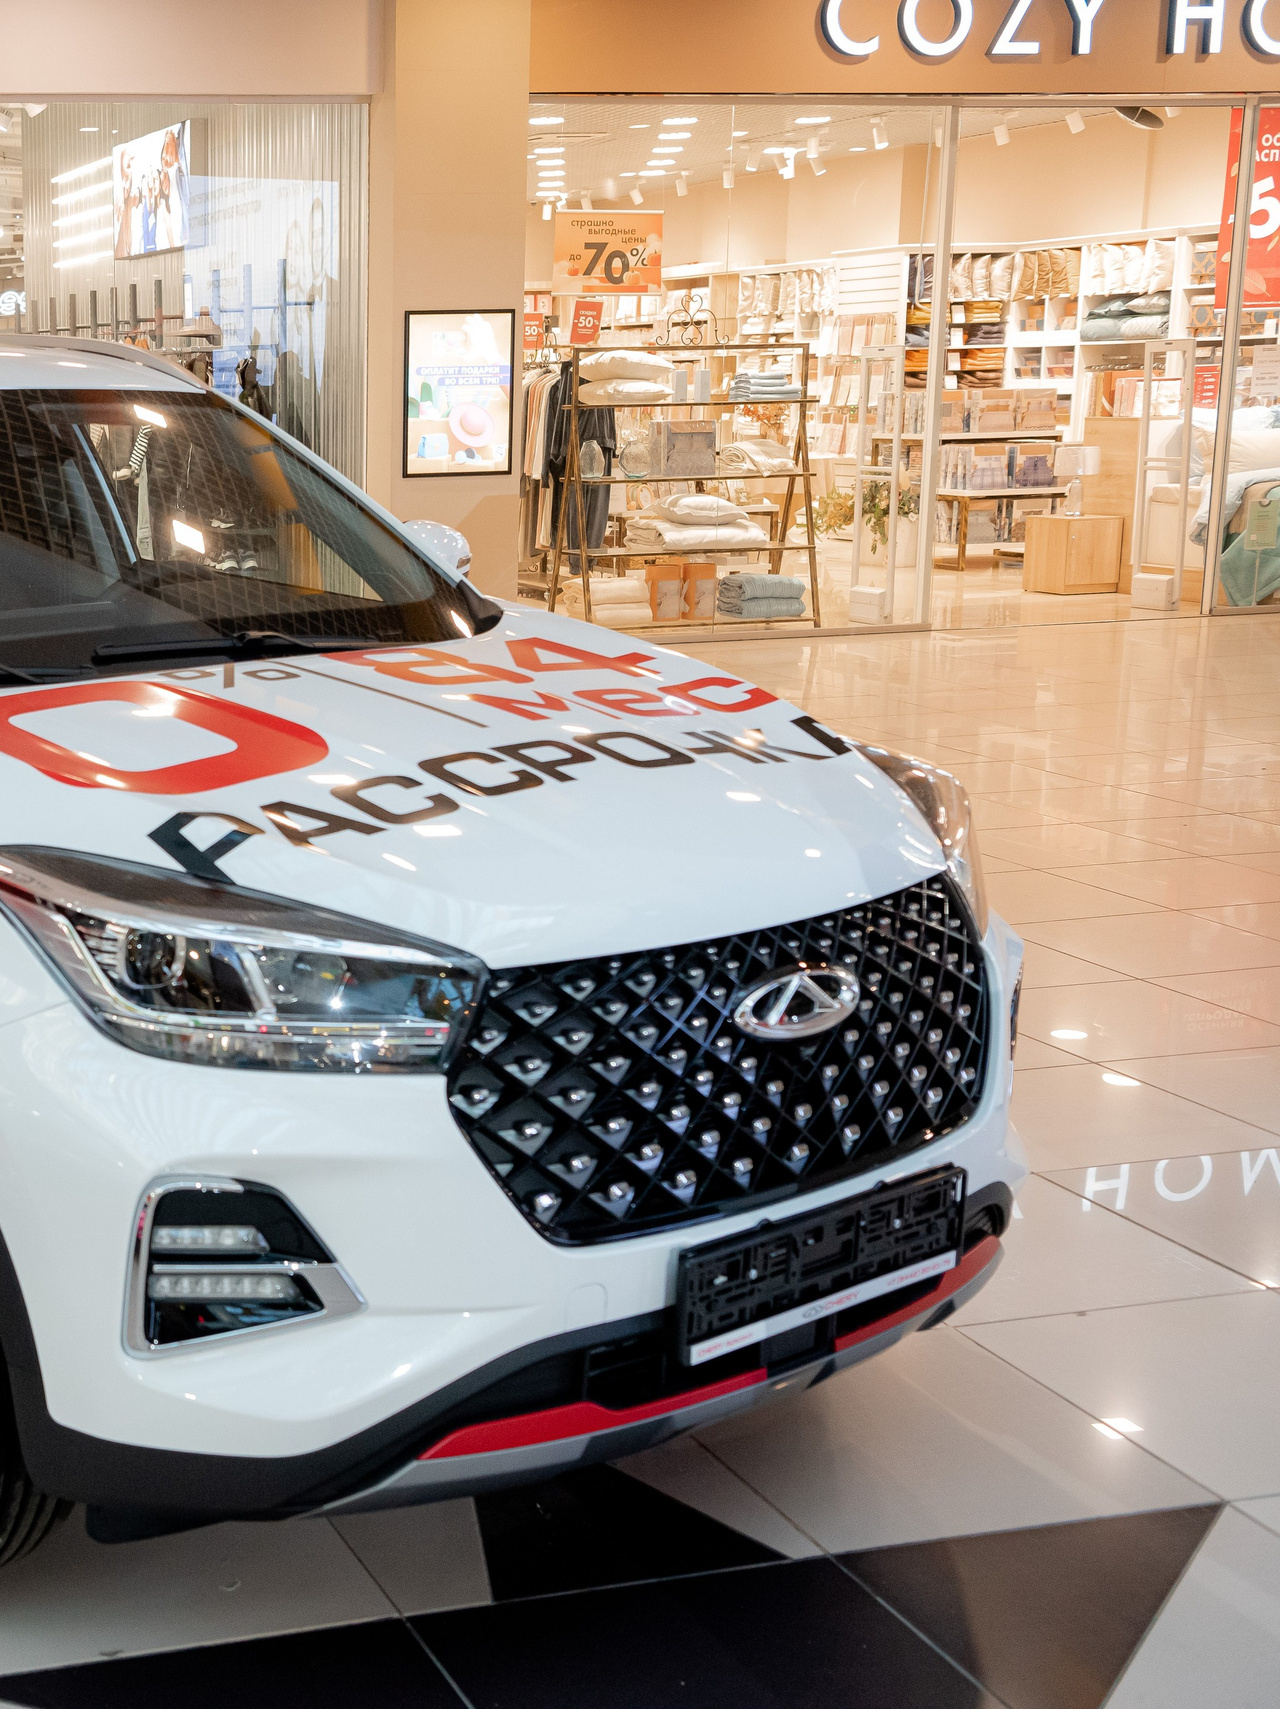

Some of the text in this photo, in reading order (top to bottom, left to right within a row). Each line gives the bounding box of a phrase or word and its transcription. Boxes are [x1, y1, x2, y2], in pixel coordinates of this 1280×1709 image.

[571, 219, 614, 229] страшно
[588, 228, 637, 236] выгодные
[621, 236, 647, 244] цены
[569, 254, 582, 262] до
[420, 366, 500, 375] ОПЛАТИТ ПОДАРКИ
[445, 377, 456, 385] ВО
[458, 377, 480, 385] ВСЕМ
[321, 636, 661, 686] 84
[469, 676, 780, 722] мес
